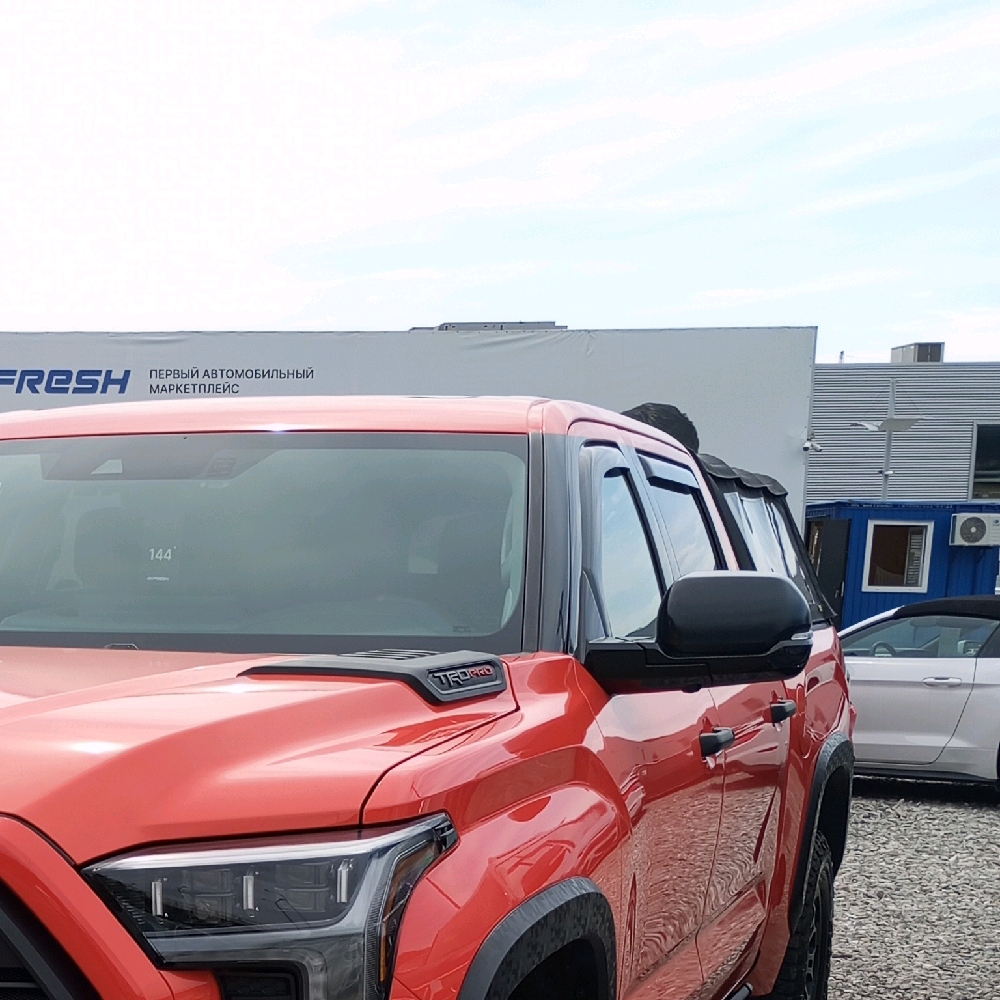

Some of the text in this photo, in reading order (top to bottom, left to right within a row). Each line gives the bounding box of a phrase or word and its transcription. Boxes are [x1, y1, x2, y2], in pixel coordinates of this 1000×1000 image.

[149, 367, 314, 380] ПЕРВЫЙ АВТОМОБИЛЬНЫЙ
[149, 382, 240, 394] МАРКЕТПЛЕЙС
